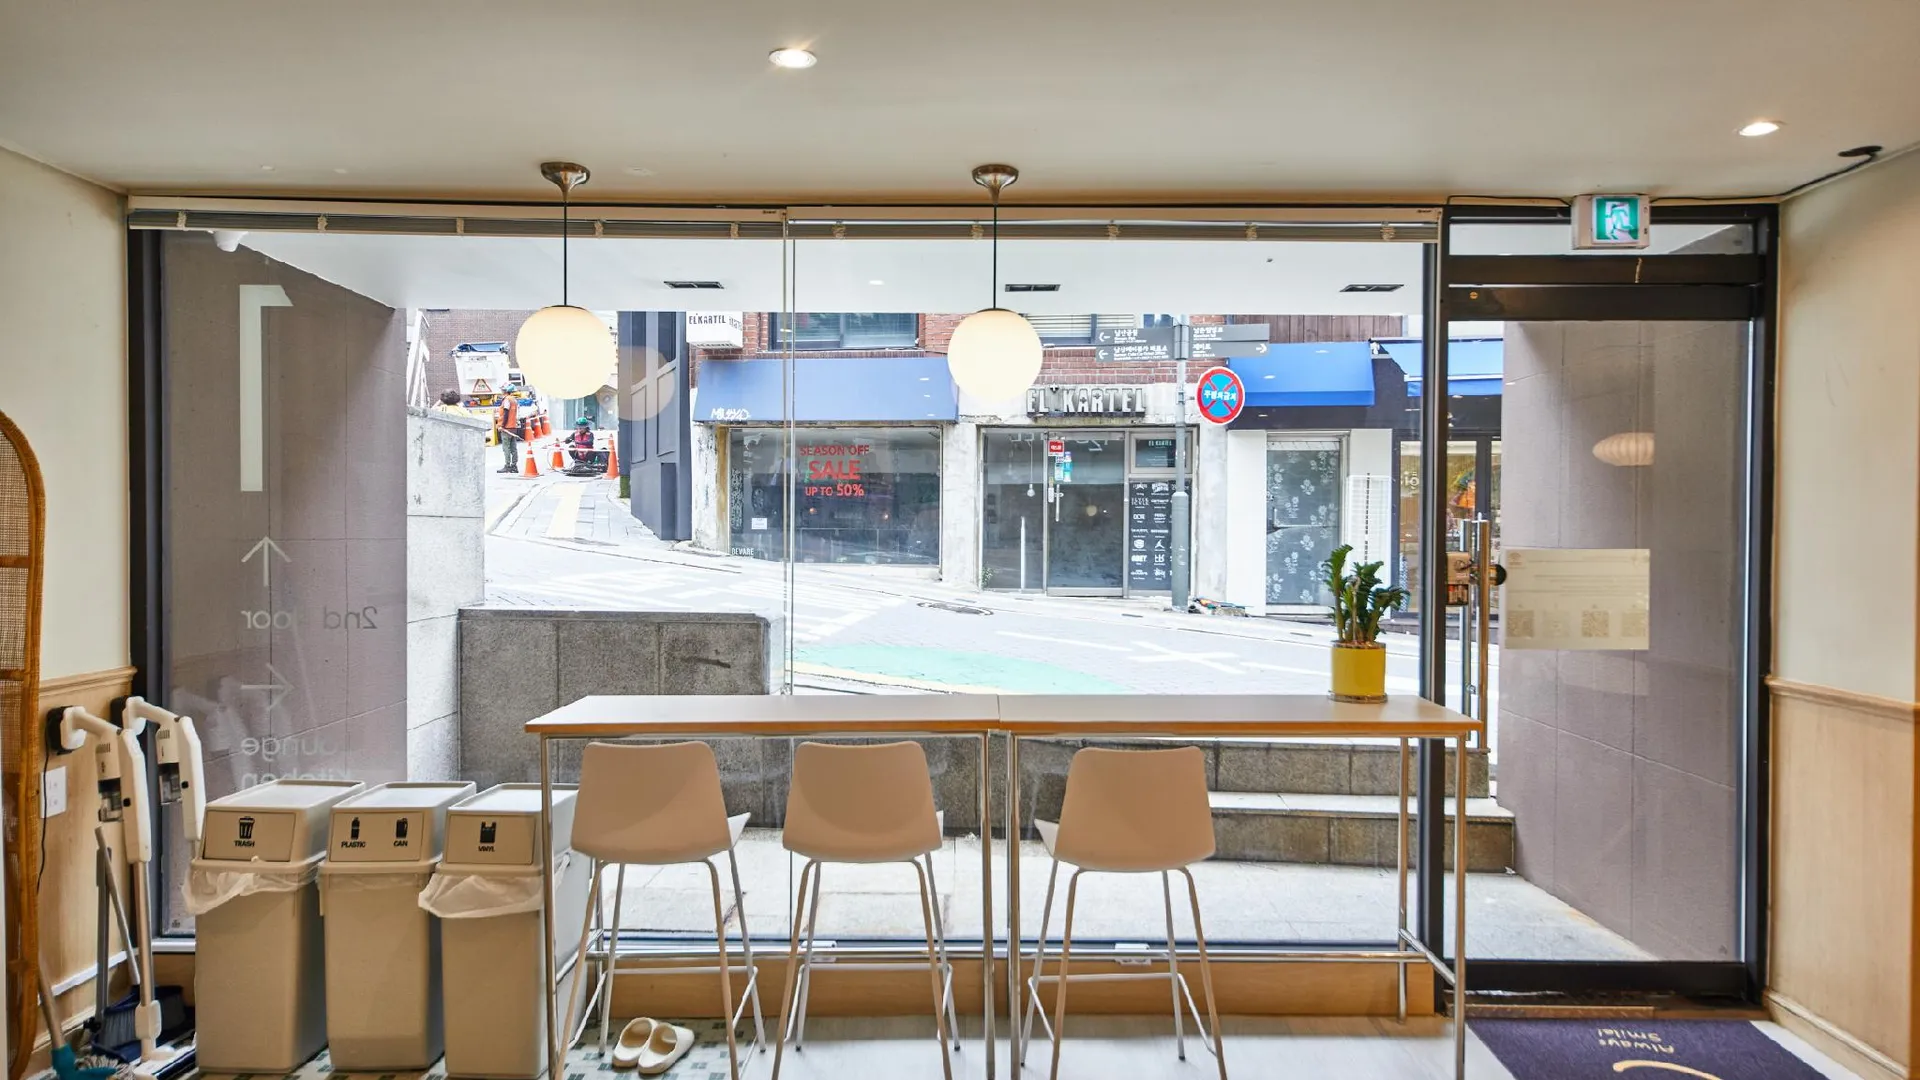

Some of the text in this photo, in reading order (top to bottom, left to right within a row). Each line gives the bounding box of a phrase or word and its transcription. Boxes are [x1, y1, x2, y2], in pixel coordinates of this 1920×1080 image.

[1026, 387, 1147, 415] EL KARTEL
[799, 444, 870, 456] SEASON OFF
[808, 460, 861, 480] SALE
[805, 483, 865, 497] UP TO 50%
[233, 840, 256, 848] TRASH
[341, 841, 367, 849] PLASTIC
[1598, 1038, 1675, 1054] Always
